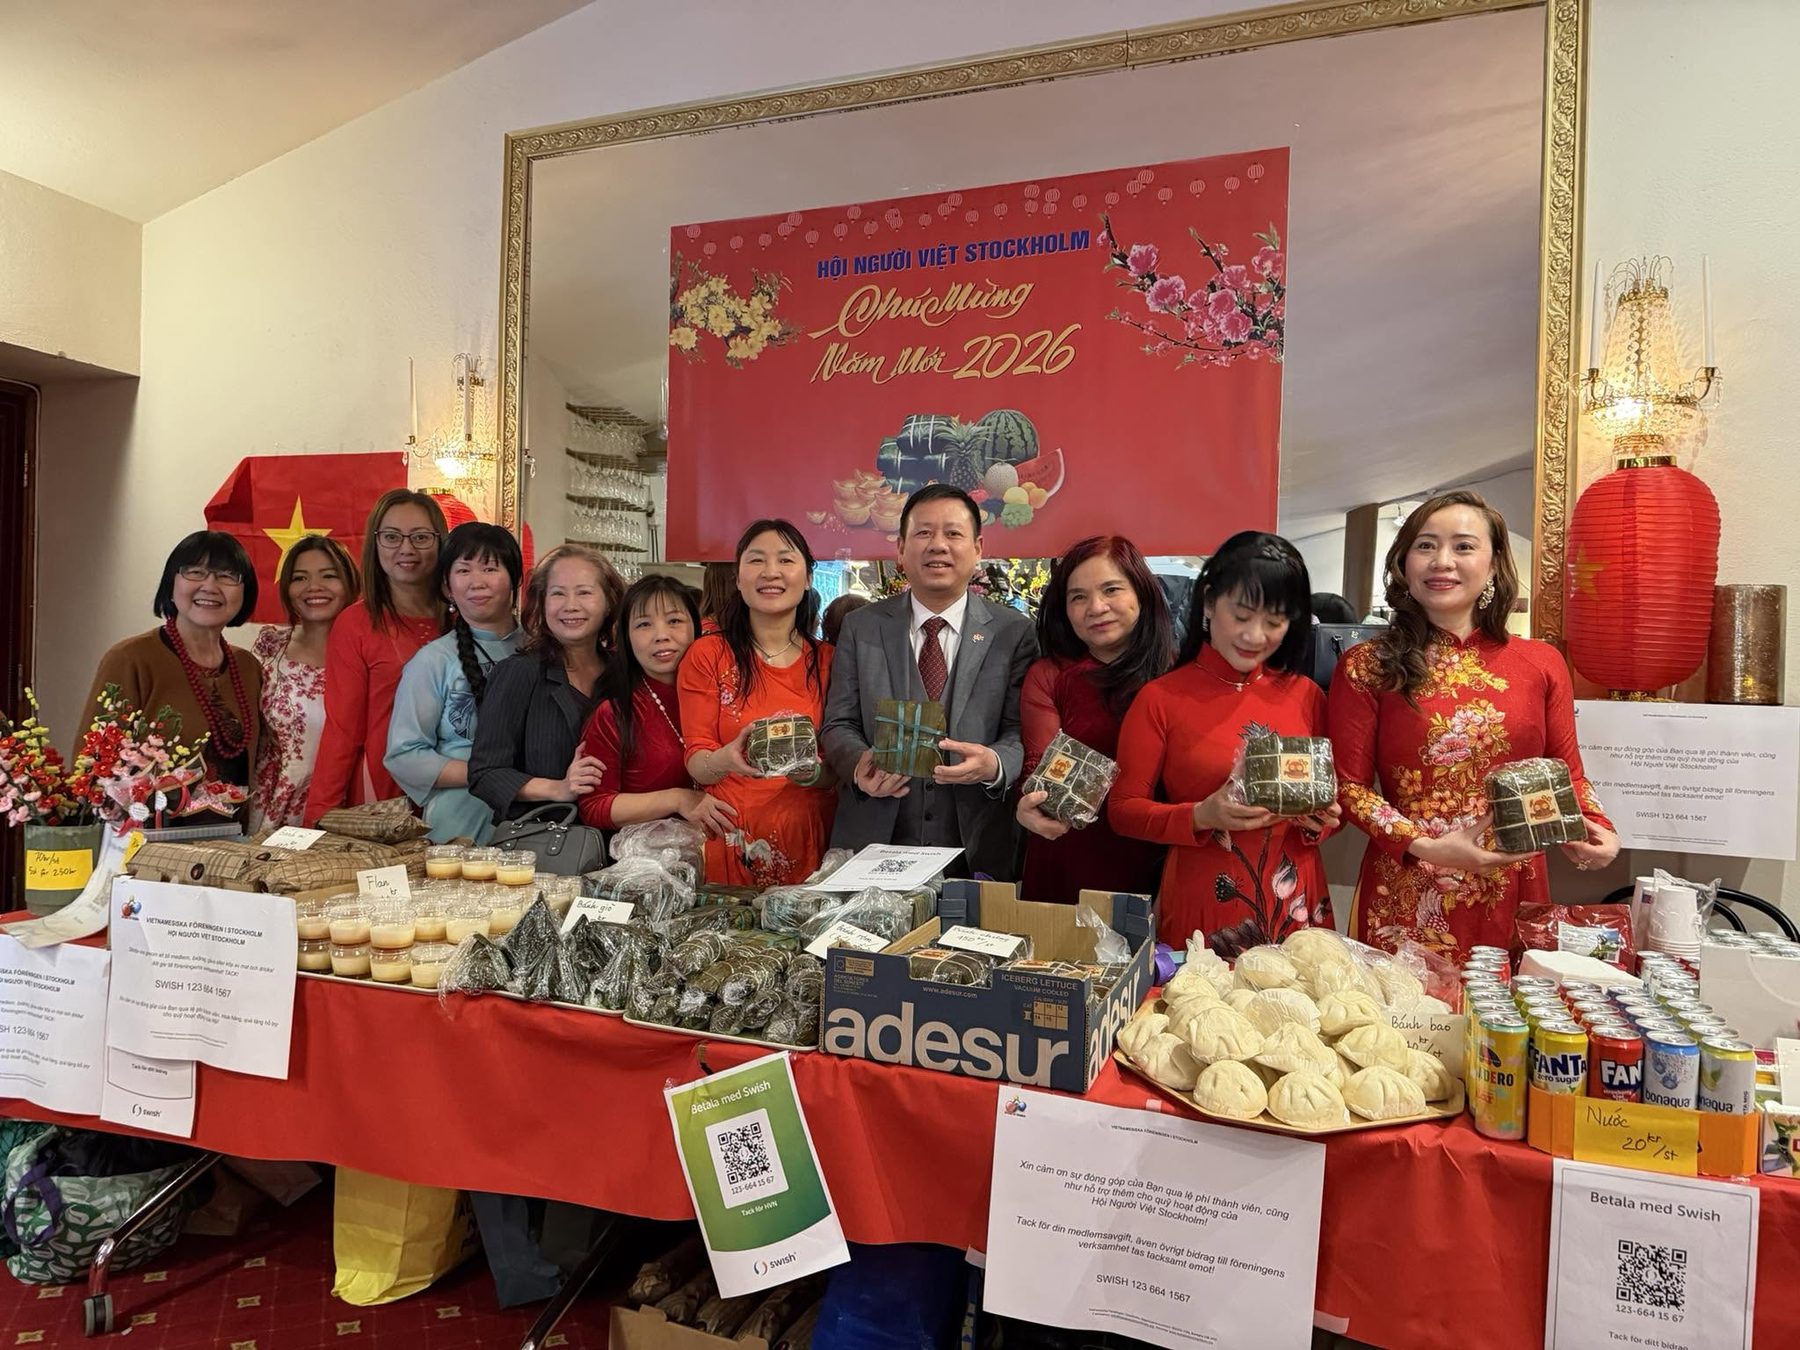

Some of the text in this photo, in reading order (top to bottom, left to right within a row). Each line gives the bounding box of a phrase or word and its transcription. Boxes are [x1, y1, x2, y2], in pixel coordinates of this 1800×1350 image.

[816, 229, 1090, 281] HỘI NGƯỜI VIỆT STOCKHOLM
[807, 278, 1035, 339] Chúc Mừng
[809, 323, 1082, 385] Năm Mới 2026
[1636, 811, 1660, 819] SWISH
[366, 875, 390, 890] Flan
[212, 934, 246, 945] STOCKHOLM
[227, 927, 263, 938] STOCKHOLM
[155, 980, 184, 990] SWISH
[187, 983, 202, 991] 123
[215, 987, 231, 998] 1567
[1001, 973, 1079, 990] ICEBERG LETTUCE
[923, 985, 978, 999] www.adesur.com
[14, 1025, 26, 1035] 123
[1088, 967, 1140, 1090] adesur
[1391, 1013, 1451, 1031] Bánh bao
[824, 1001, 1069, 1088] adesur
[1533, 1052, 1588, 1077] FANTA
[1555, 1076, 1580, 1084] sugar
[691, 1079, 771, 1115] Betala med Swish
[1645, 1088, 1690, 1108] bonaqua
[1700, 1095, 1734, 1113] naqua
[731, 1175, 774, 1195] 123-664 15 67
[1020, 1160, 1034, 1170] Xin
[1036, 1163, 1054, 1174] cảm
[1056, 1168, 1068, 1177] ơn
[1070, 1170, 1082, 1180] sự
[1083, 1172, 1106, 1185] đóng
[1108, 1175, 1125, 1187] góp
[1127, 1177, 1143, 1188] của
[1146, 1180, 1164, 1193] Bạn
[1165, 1187, 1183, 1198] qua
[1212, 1197, 1239, 1209] thành
[1241, 1202, 1263, 1215] viên,
[1265, 1207, 1290, 1221] cũng
[740, 1201, 778, 1217] Tack för HVN
[1064, 1180, 1082, 1191] như
[1083, 1183, 1096, 1193] hỗ
[1097, 1186, 1110, 1196] trợ
[1112, 1187, 1134, 1199] thêm
[1137, 1190, 1153, 1202] cho
[1173, 1199, 1194, 1212] hoạt
[1195, 1204, 1219, 1218] động
[1220, 1209, 1238, 1221] của
[1590, 1191, 1721, 1222] Betala med Swish
[1091, 1196, 1208, 1226] Hội Người Việt Stockholm!
[1016, 1215, 1285, 1278] Tack för din medlemsavgift, även övrigt bidrag till föreningens
[770, 1252, 795, 1269] swish
[1078, 1240, 1215, 1274] verksamhet tas tacksamt emot!
[1096, 1274, 1191, 1303] SWISH 123 664 1567
[1616, 1304, 1684, 1323] 123-664 15 67
[1609, 1331, 1628, 1342] Tack
[1645, 1337, 1659, 1347] ditt
